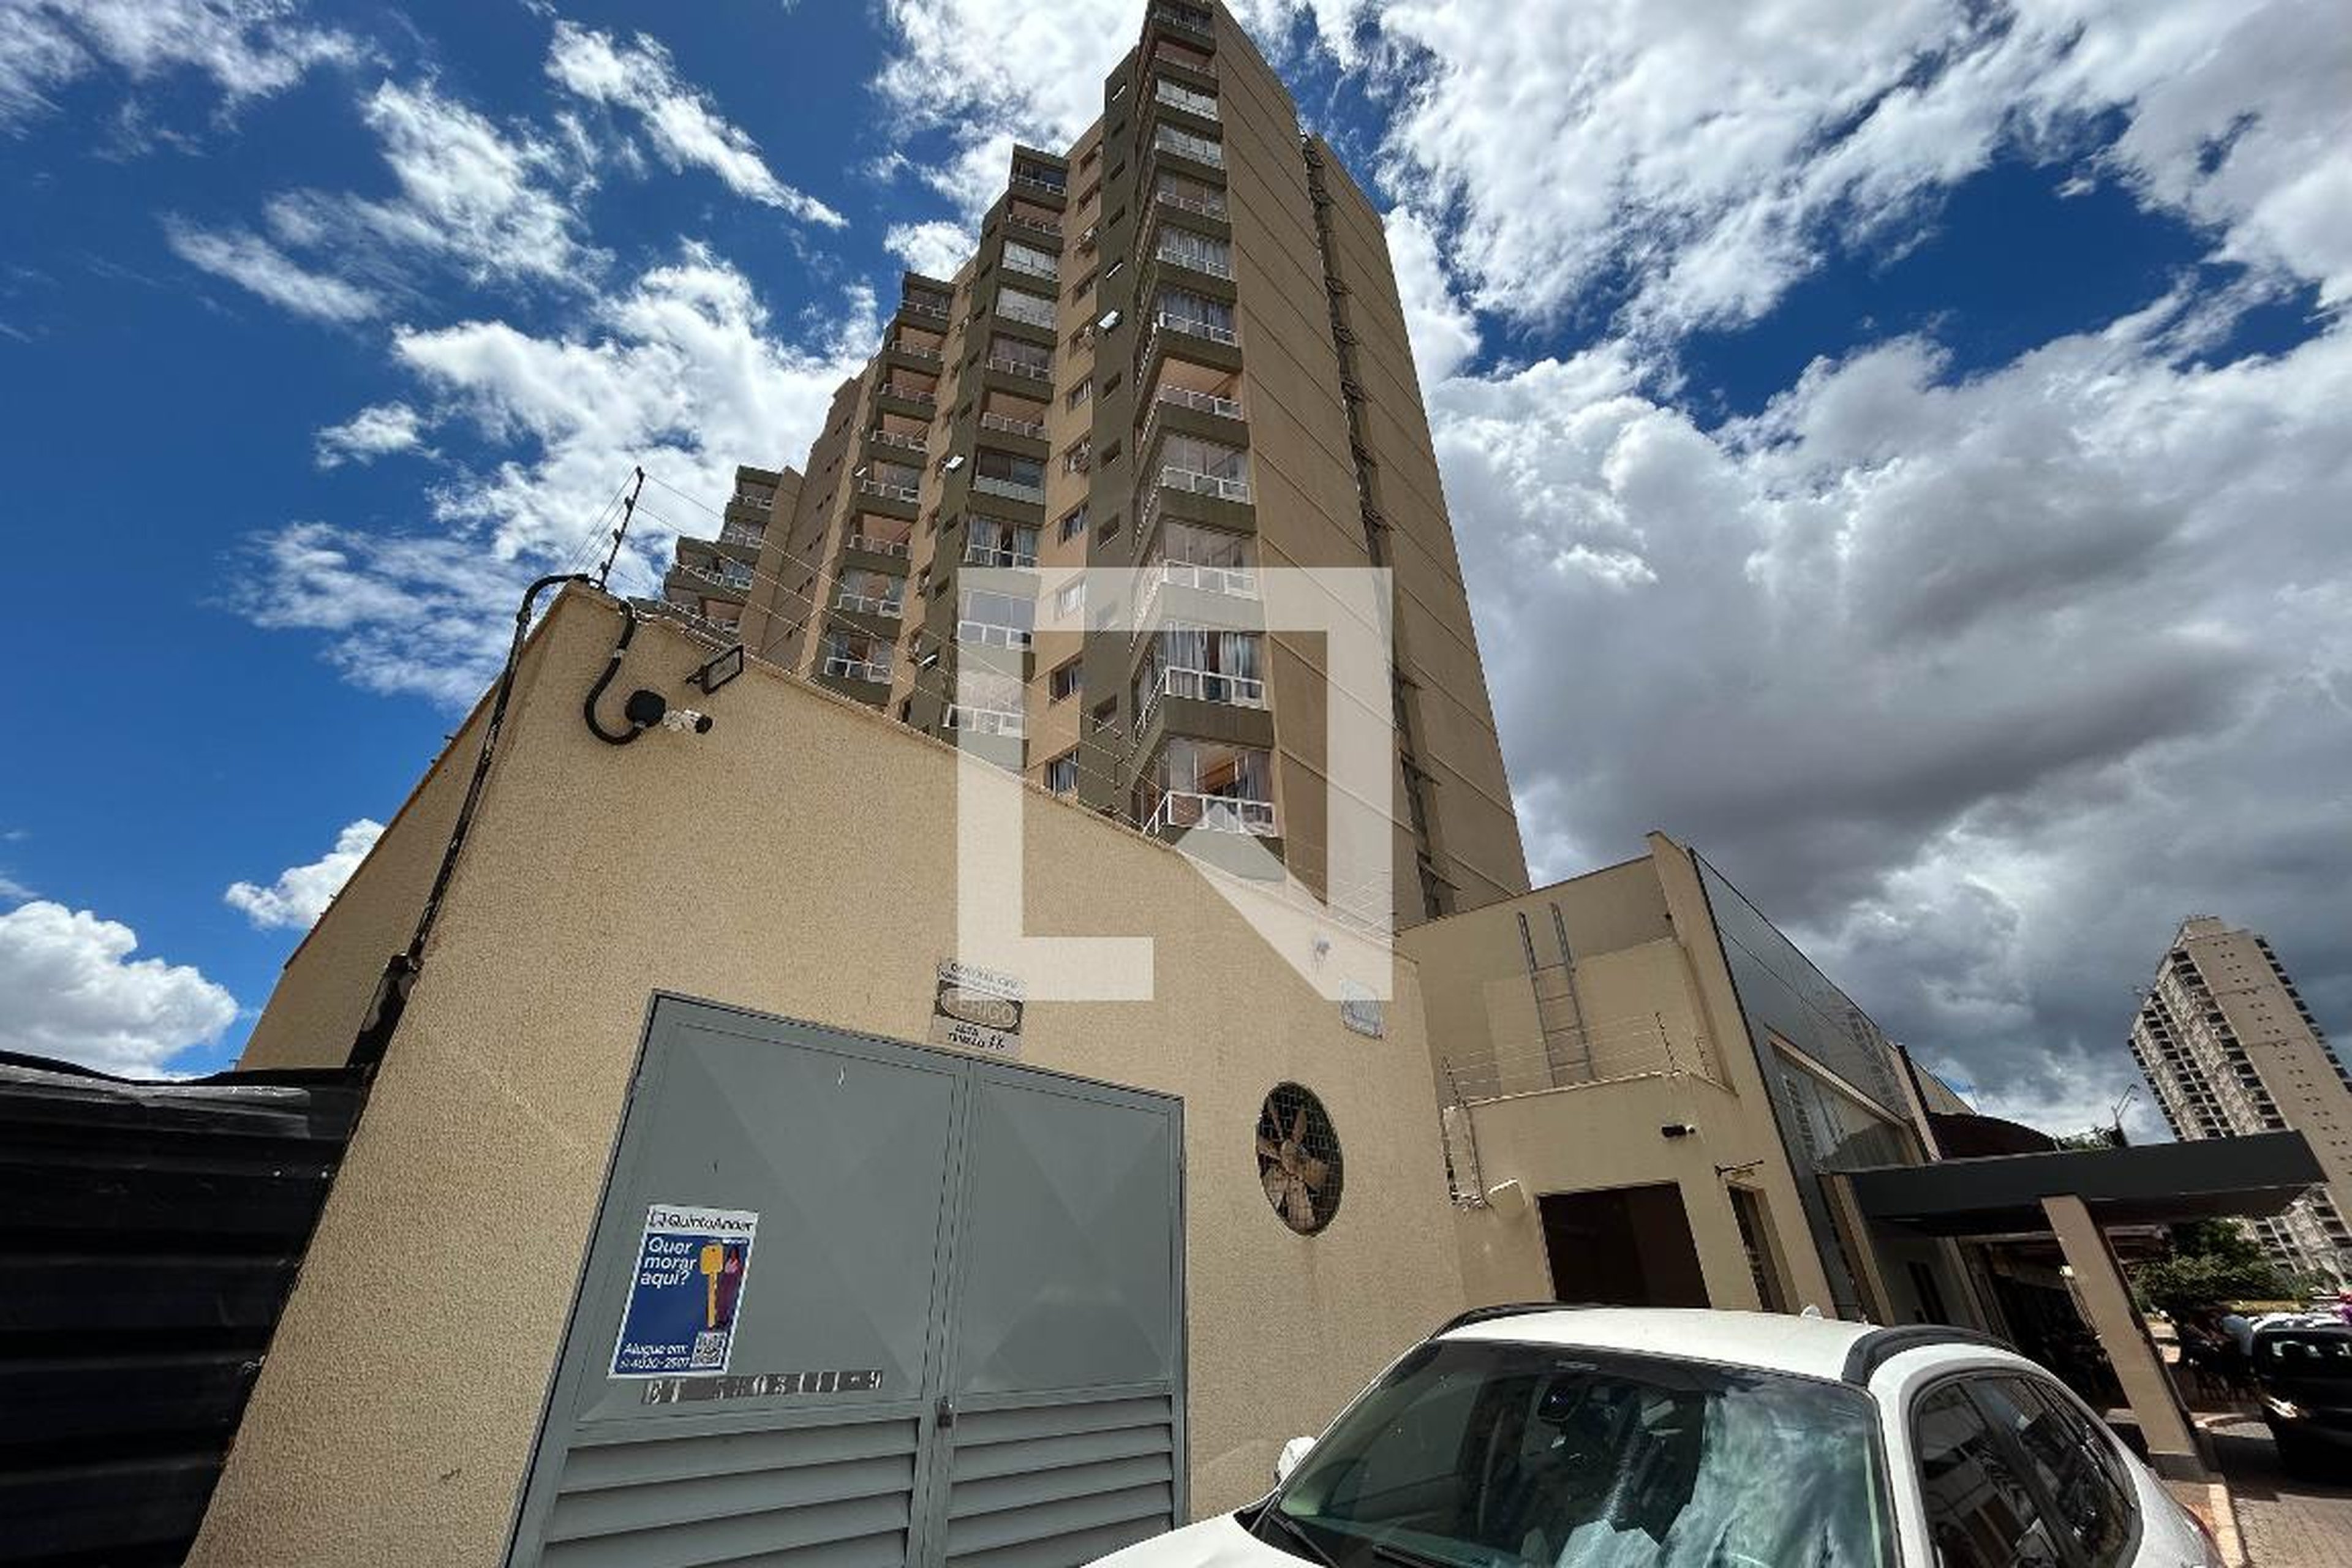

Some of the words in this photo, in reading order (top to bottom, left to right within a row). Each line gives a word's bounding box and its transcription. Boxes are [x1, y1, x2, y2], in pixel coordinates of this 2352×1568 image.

[649, 1237, 692, 1254] Quer
[644, 1256, 696, 1270] morar
[640, 1270, 690, 1289] aqui?
